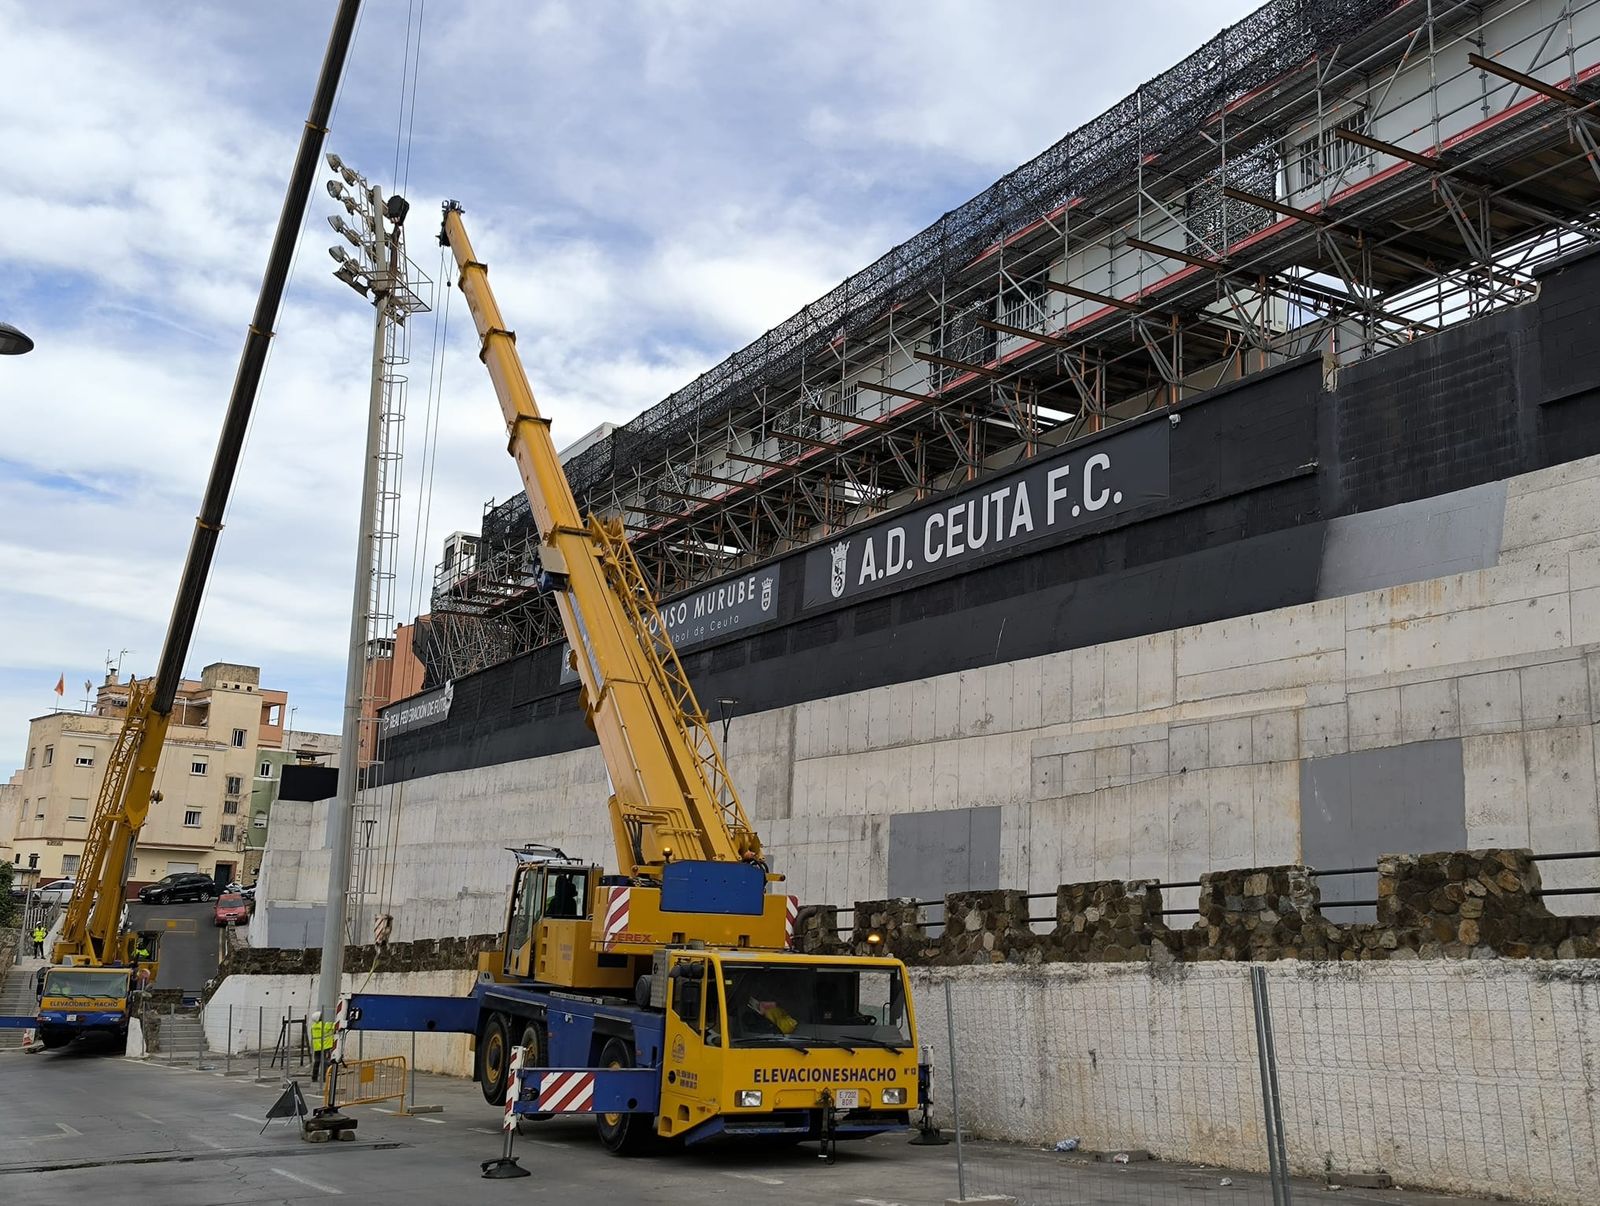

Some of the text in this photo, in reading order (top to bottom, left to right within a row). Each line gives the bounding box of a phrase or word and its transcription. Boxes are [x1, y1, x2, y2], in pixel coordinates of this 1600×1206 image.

[858, 453, 1123, 585] A.D. CEUTA F.C.
[693, 576, 756, 619] MURUBE
[694, 625, 705, 635] de
[710, 614, 739, 631] Ceuta
[610, 932, 652, 942] TEREX
[754, 1067, 897, 1083] ELEVACIONESHACHO
